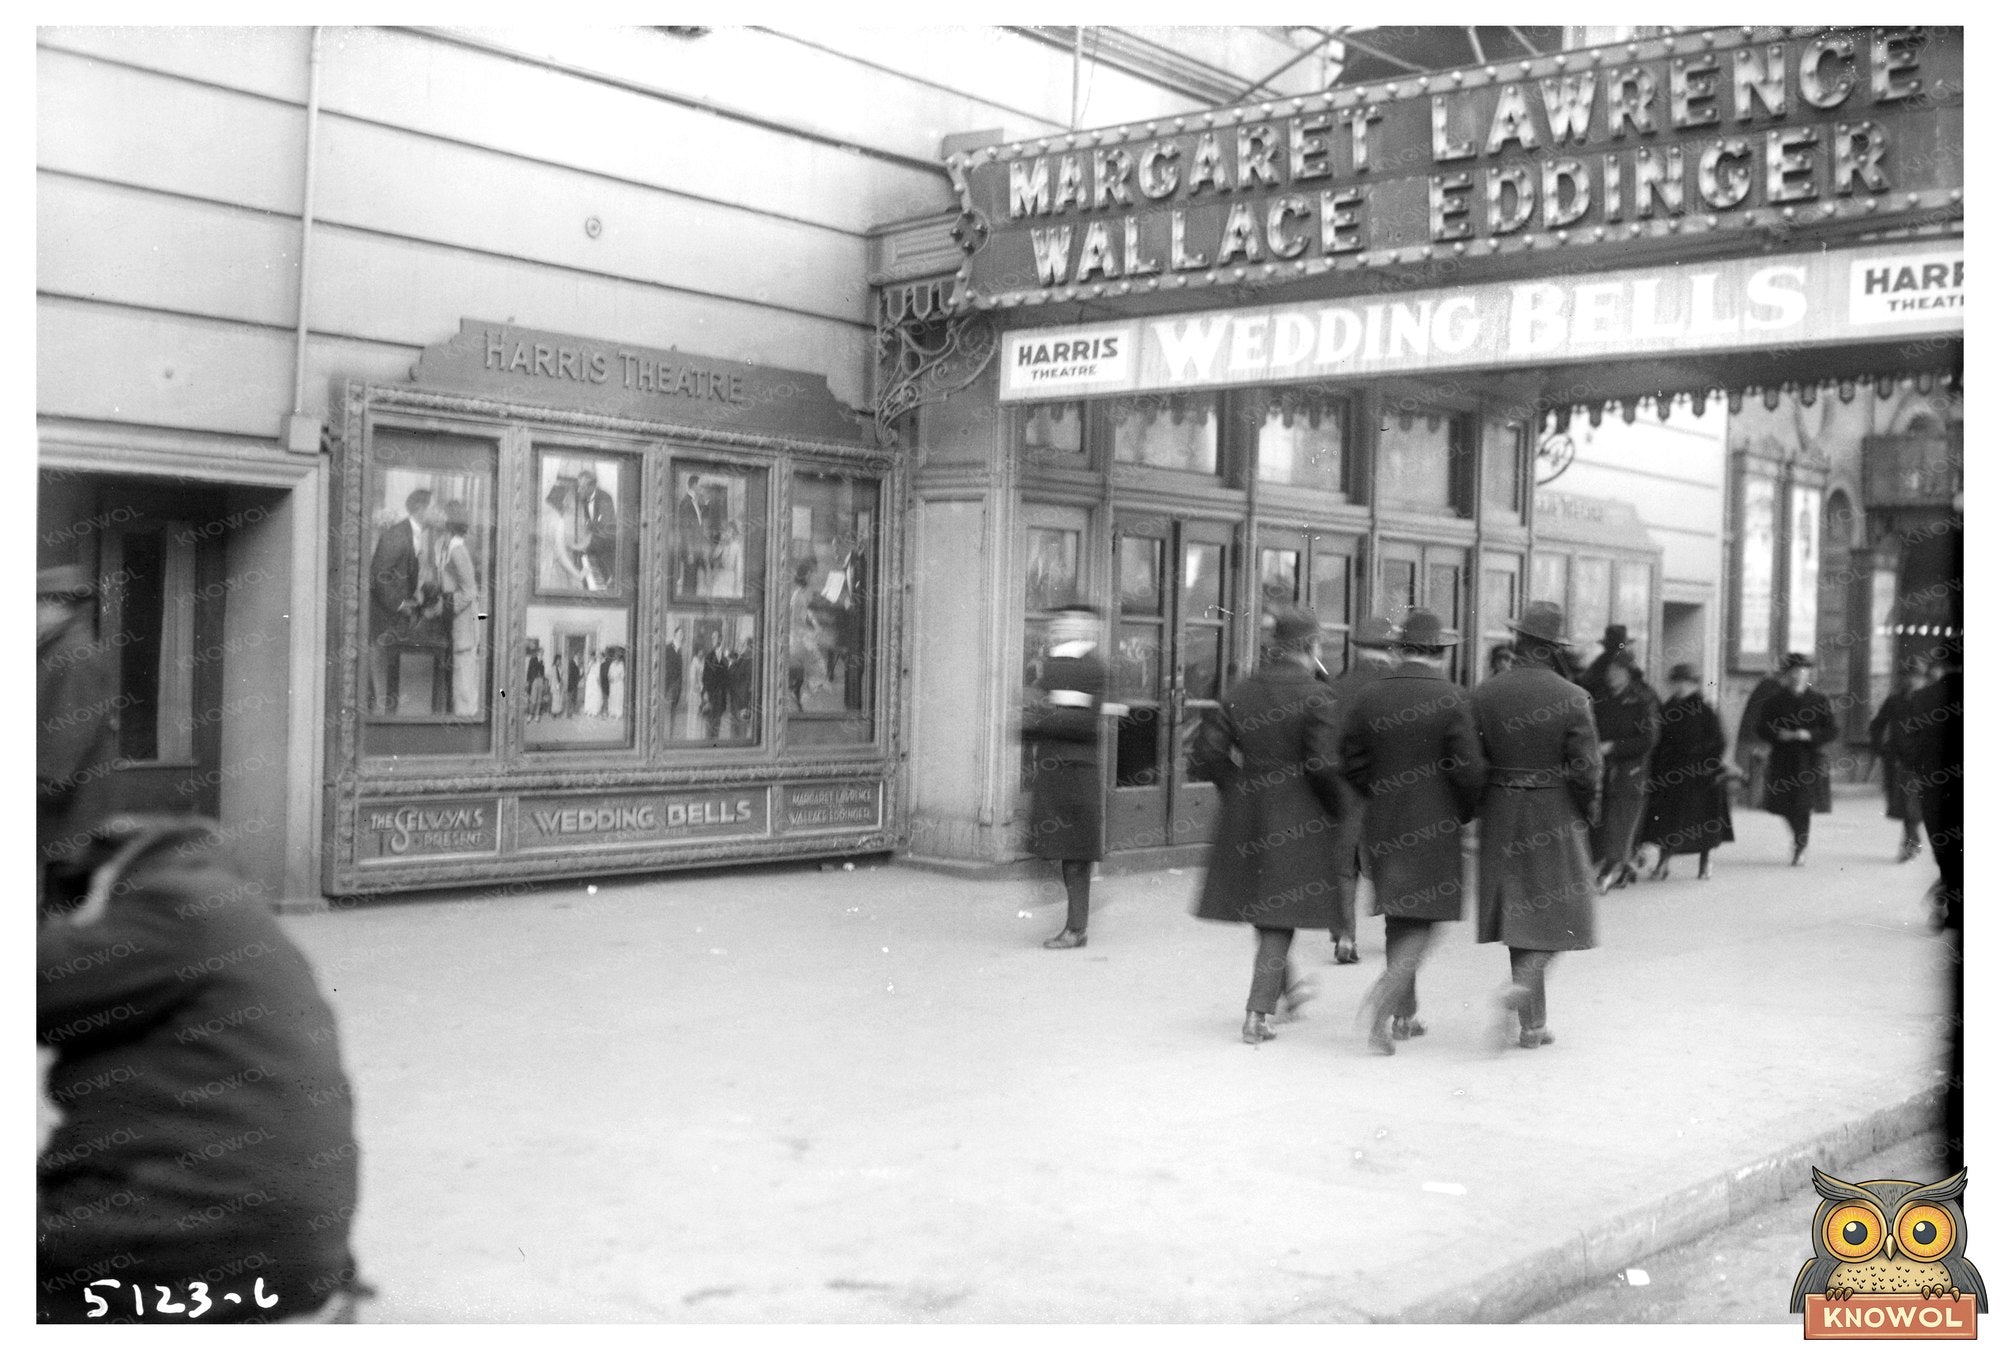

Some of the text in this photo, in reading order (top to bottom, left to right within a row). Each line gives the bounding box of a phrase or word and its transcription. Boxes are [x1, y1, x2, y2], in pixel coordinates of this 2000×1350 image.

[1009, 27, 1925, 219] MARGARET LAWRENCE
[1030, 120, 1890, 286] WALLACE EDDINGER
[1888, 294, 1963, 312] THEAT
[1151, 298, 1483, 381] WEDDING
[1507, 266, 1809, 356] BELLS
[483, 330, 743, 403] HARRIS THEATRE
[1018, 337, 1119, 367] HARRIS
[1030, 364, 1098, 381] THEATRE
[370, 812, 394, 830] THE
[532, 805, 656, 837] WEDDING
[666, 800, 751, 827] BELLS
